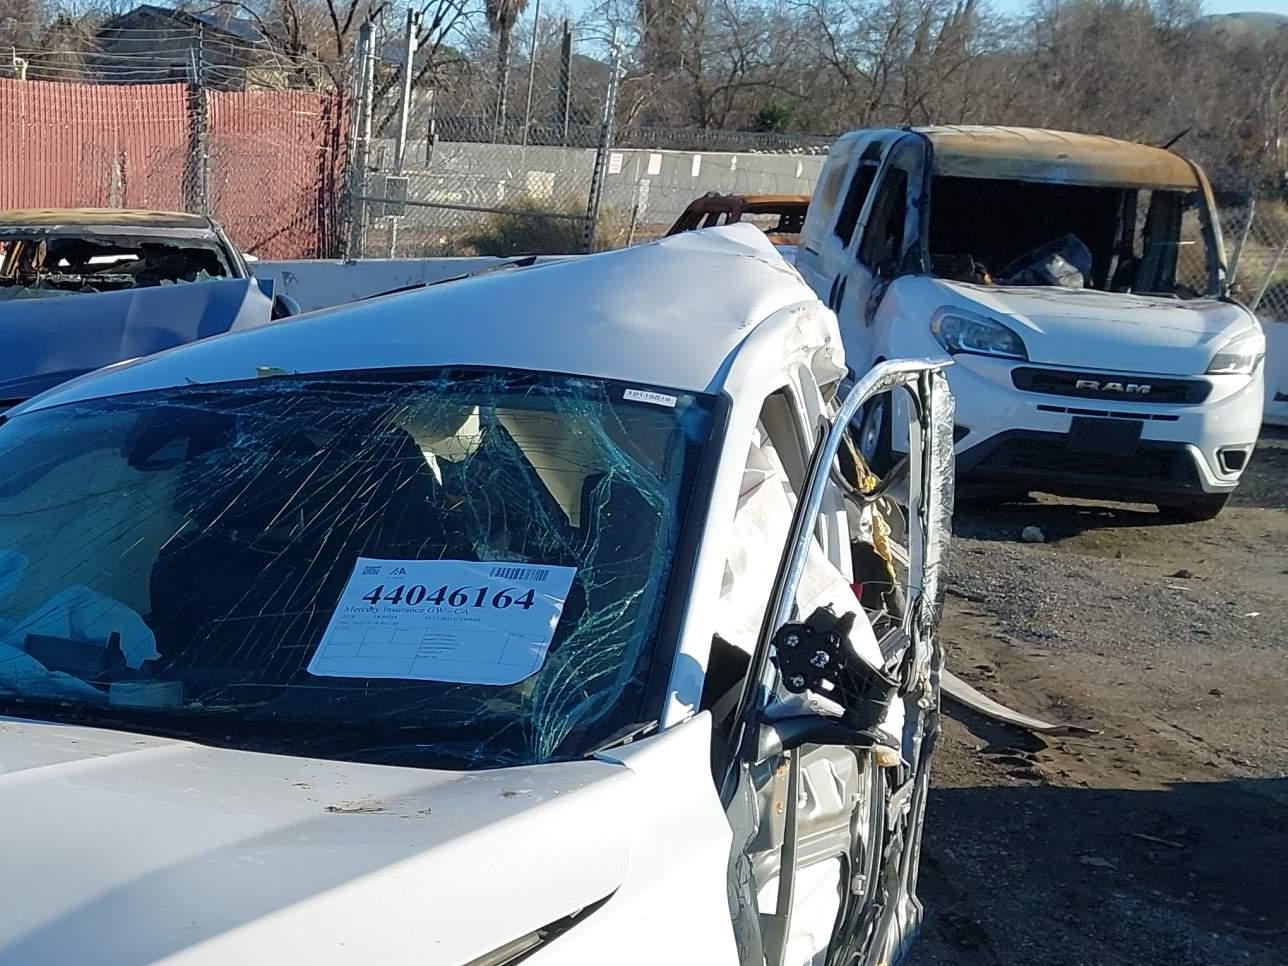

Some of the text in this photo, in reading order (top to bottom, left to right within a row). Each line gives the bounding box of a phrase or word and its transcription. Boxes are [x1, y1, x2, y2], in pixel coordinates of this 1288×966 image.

[1076, 380, 1152, 394] RAM
[362, 584, 536, 610] 44046164
[383, 606, 425, 615] Insurance
